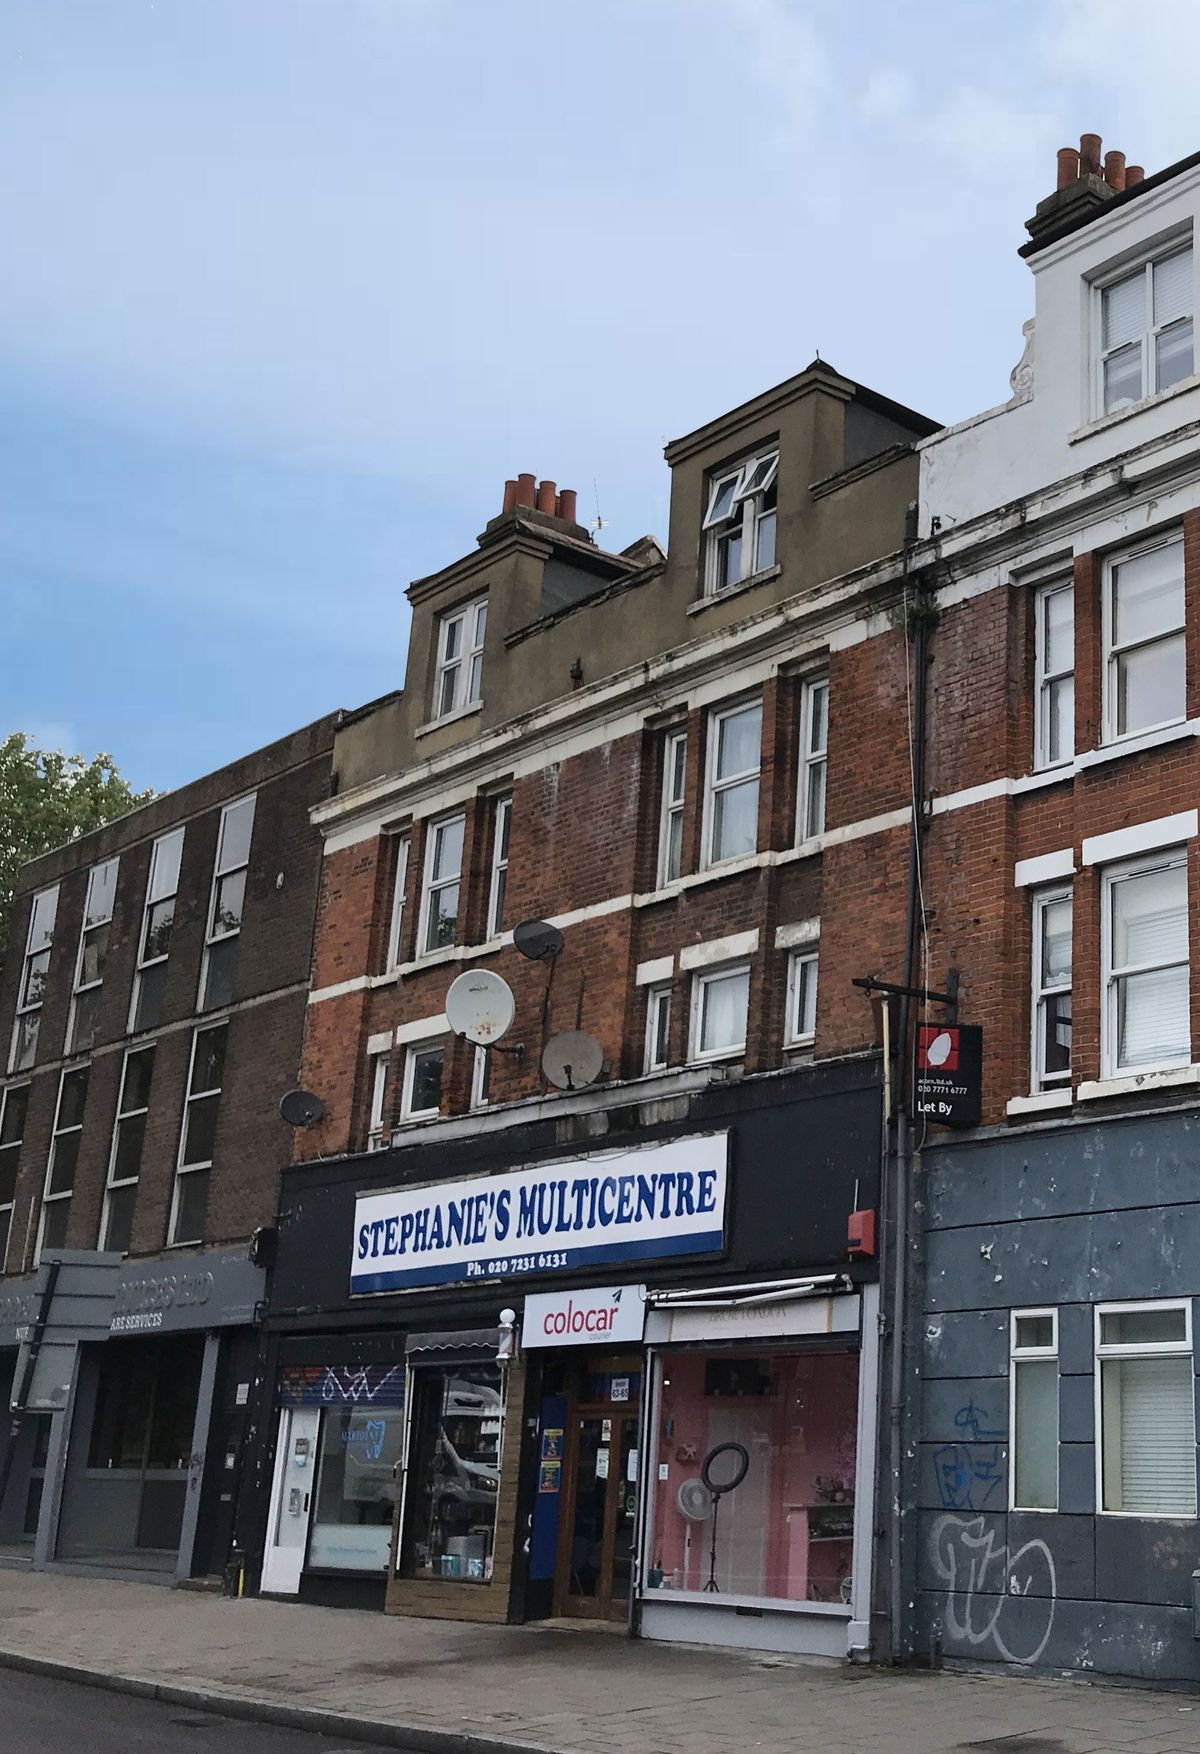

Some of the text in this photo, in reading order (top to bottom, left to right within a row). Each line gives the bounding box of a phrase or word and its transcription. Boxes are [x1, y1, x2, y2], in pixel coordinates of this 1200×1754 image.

[917, 1101, 952, 1115] Let By
[358, 1170, 718, 1259] STEPHANIE'S MULTICENTRE
[467, 1252, 568, 1276] Ph. 020 7231 6131
[125, 1311, 163, 1329] SERVICES
[544, 1300, 619, 1335] colocar
